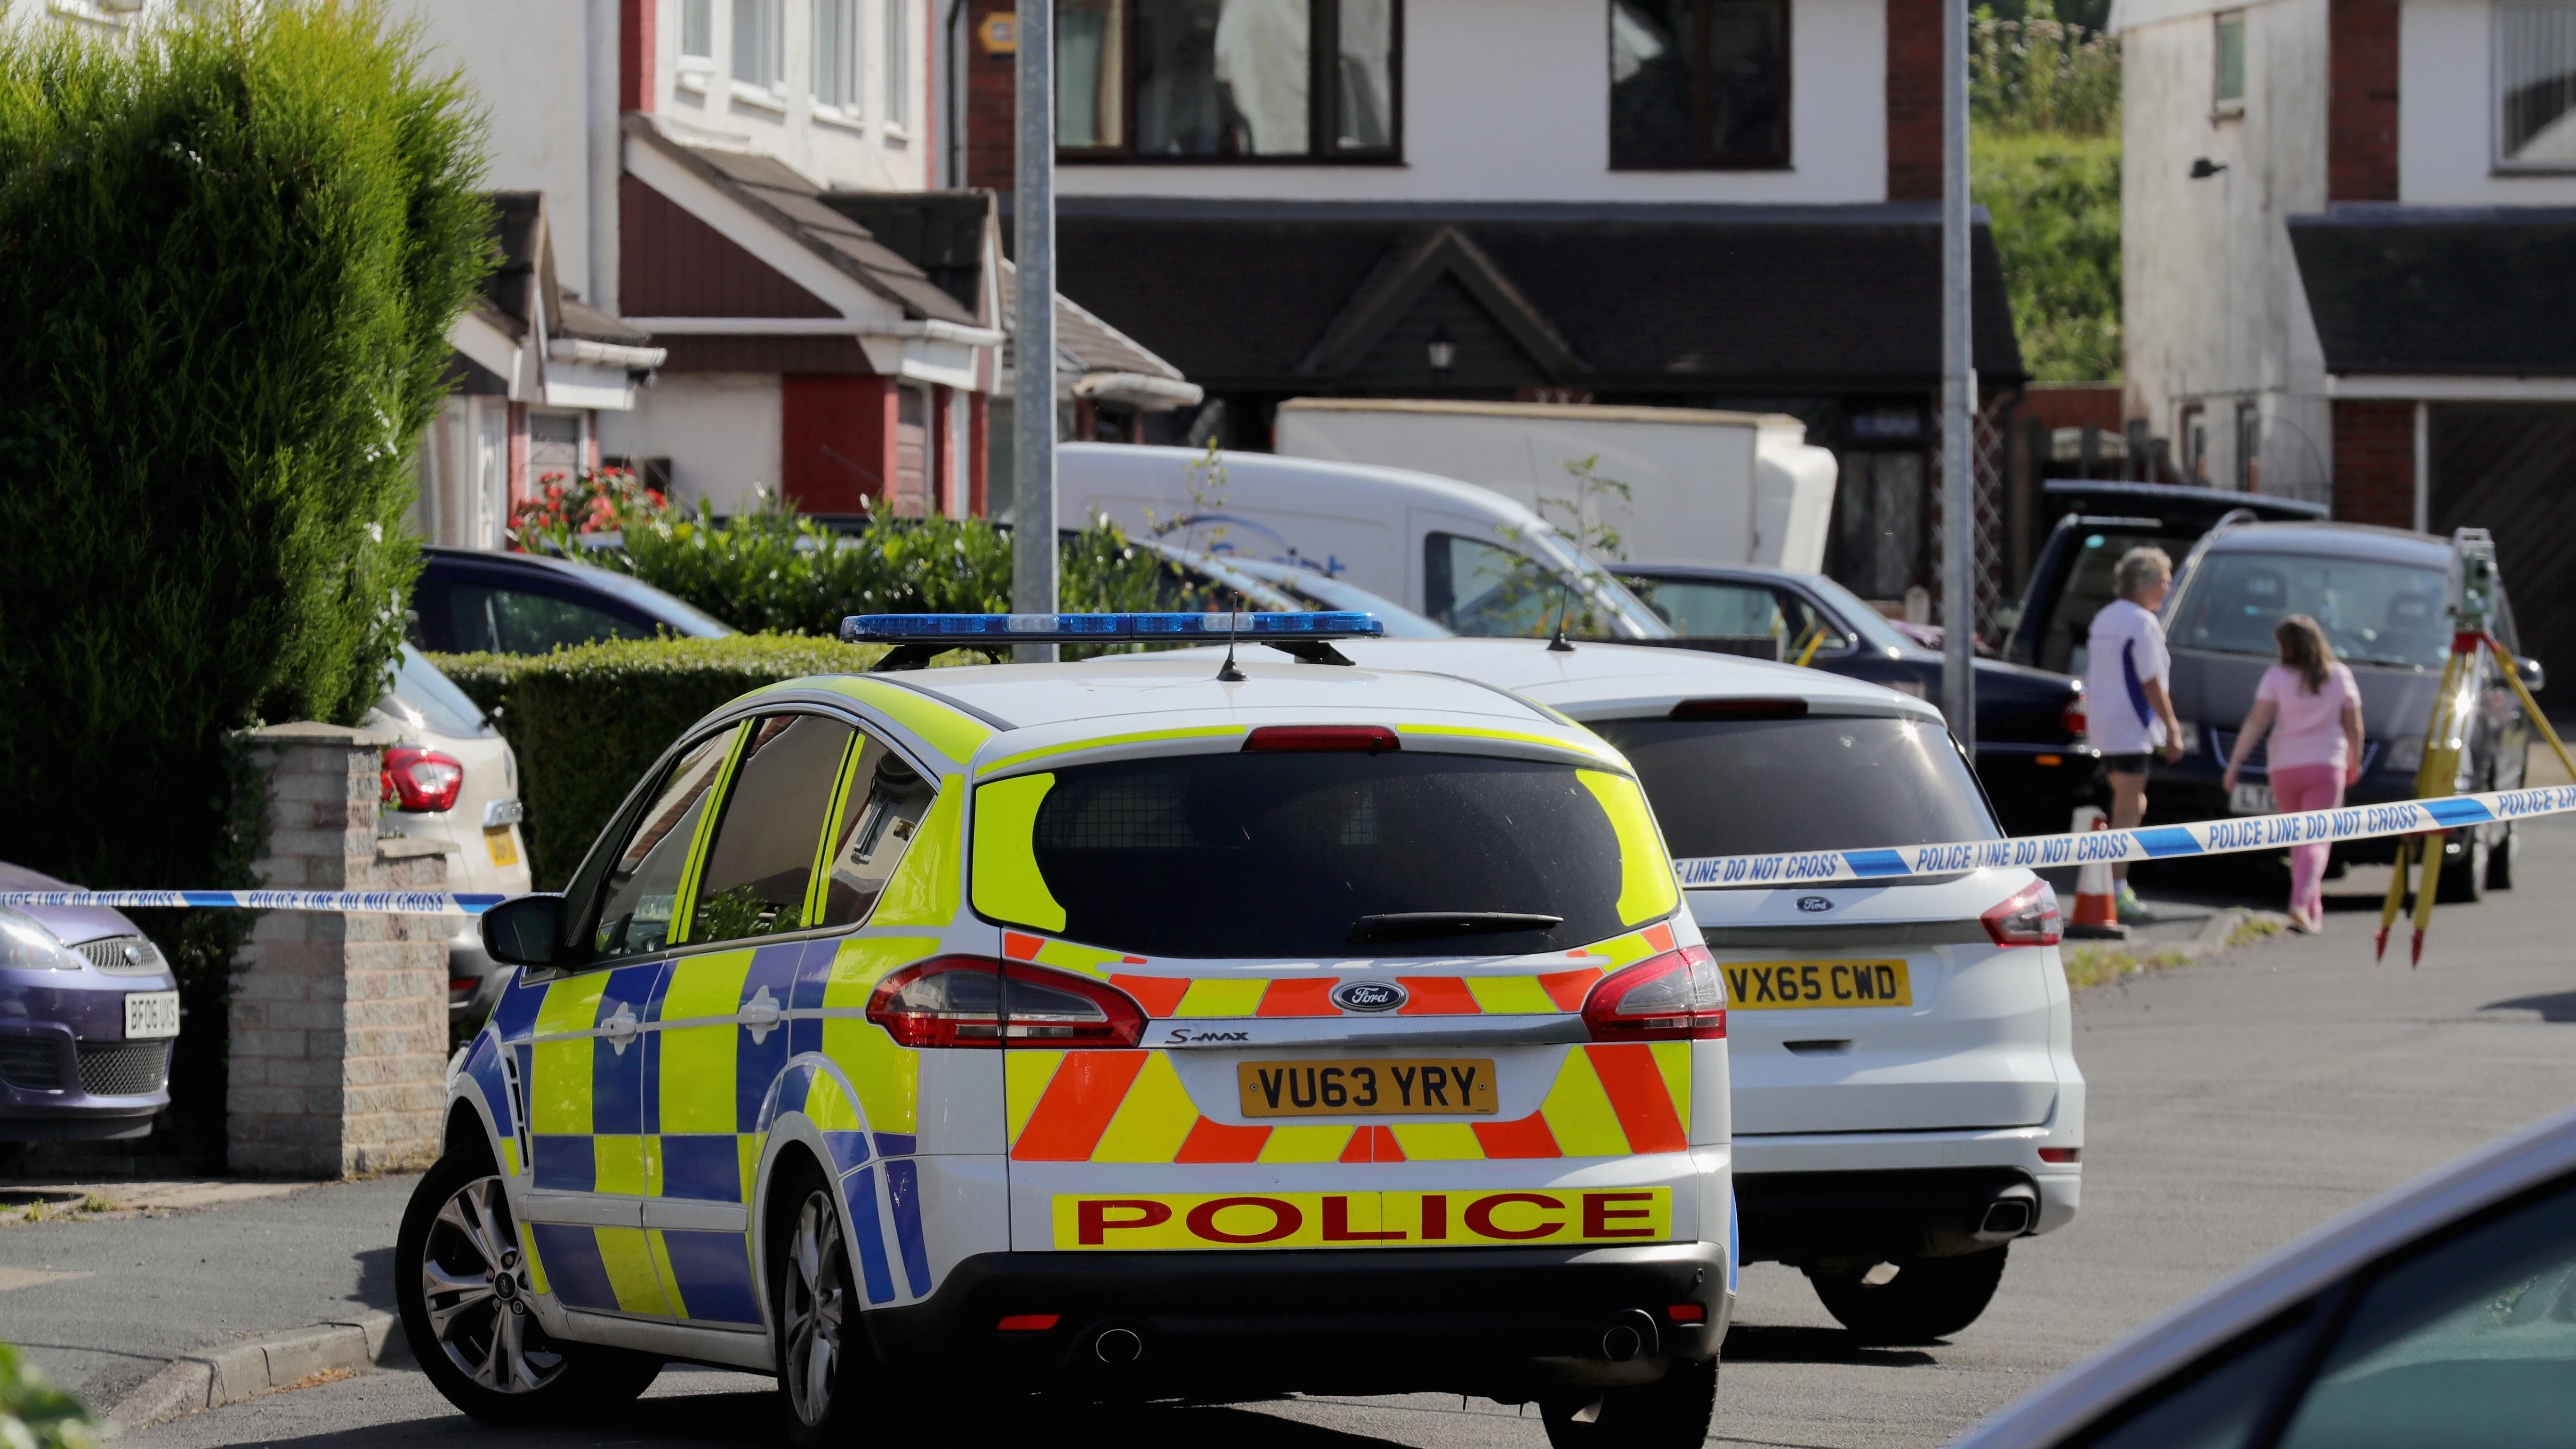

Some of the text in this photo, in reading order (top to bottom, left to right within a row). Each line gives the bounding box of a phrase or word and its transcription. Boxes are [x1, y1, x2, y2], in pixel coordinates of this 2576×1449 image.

[2497, 790, 2552, 817] POLICE
[2208, 805, 2417, 849] POLICE LINE DO NOT CROSS
[1685, 860, 1721, 884] LINE
[1723, 859, 1747, 882] DO
[1750, 857, 1783, 880] NOT
[1786, 854, 1838, 878] CROSS
[1916, 834, 2128, 871] POLICE LINE DO NOT CROSS
[249, 892, 446, 912] POLICE LINE DO NOT CROSS
[1804, 899, 1827, 910] Ford
[1352, 987, 1388, 1003] Ford
[1728, 965, 1897, 1003] VX65 CWD
[1257, 1066, 1476, 1108] VU63 YRY
[1078, 1192, 1655, 1245] POLICE
